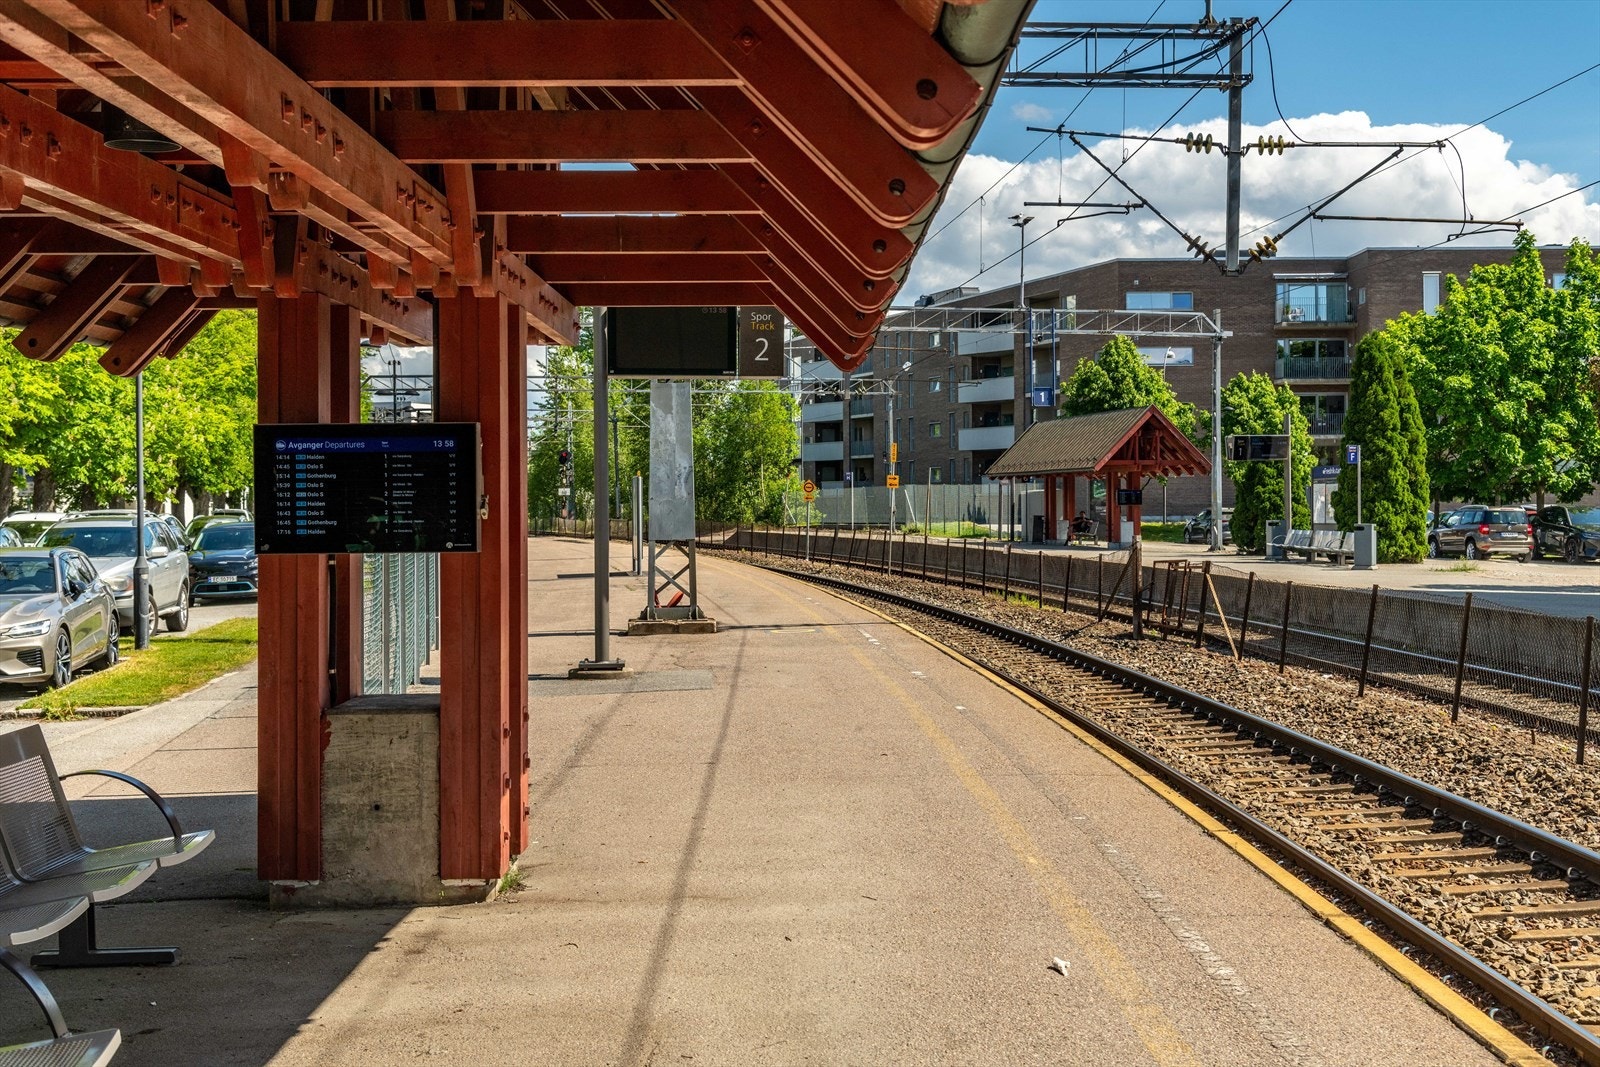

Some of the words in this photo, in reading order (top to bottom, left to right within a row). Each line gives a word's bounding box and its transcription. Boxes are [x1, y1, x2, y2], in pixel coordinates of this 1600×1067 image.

[750, 312, 771, 322] Spor
[751, 322, 774, 330] Track
[754, 338, 769, 361] 2
[1040, 392, 1044, 402] 1
[288, 441, 324, 450] Avganger
[325, 441, 365, 450] Departures
[1350, 452, 1355, 461] F
